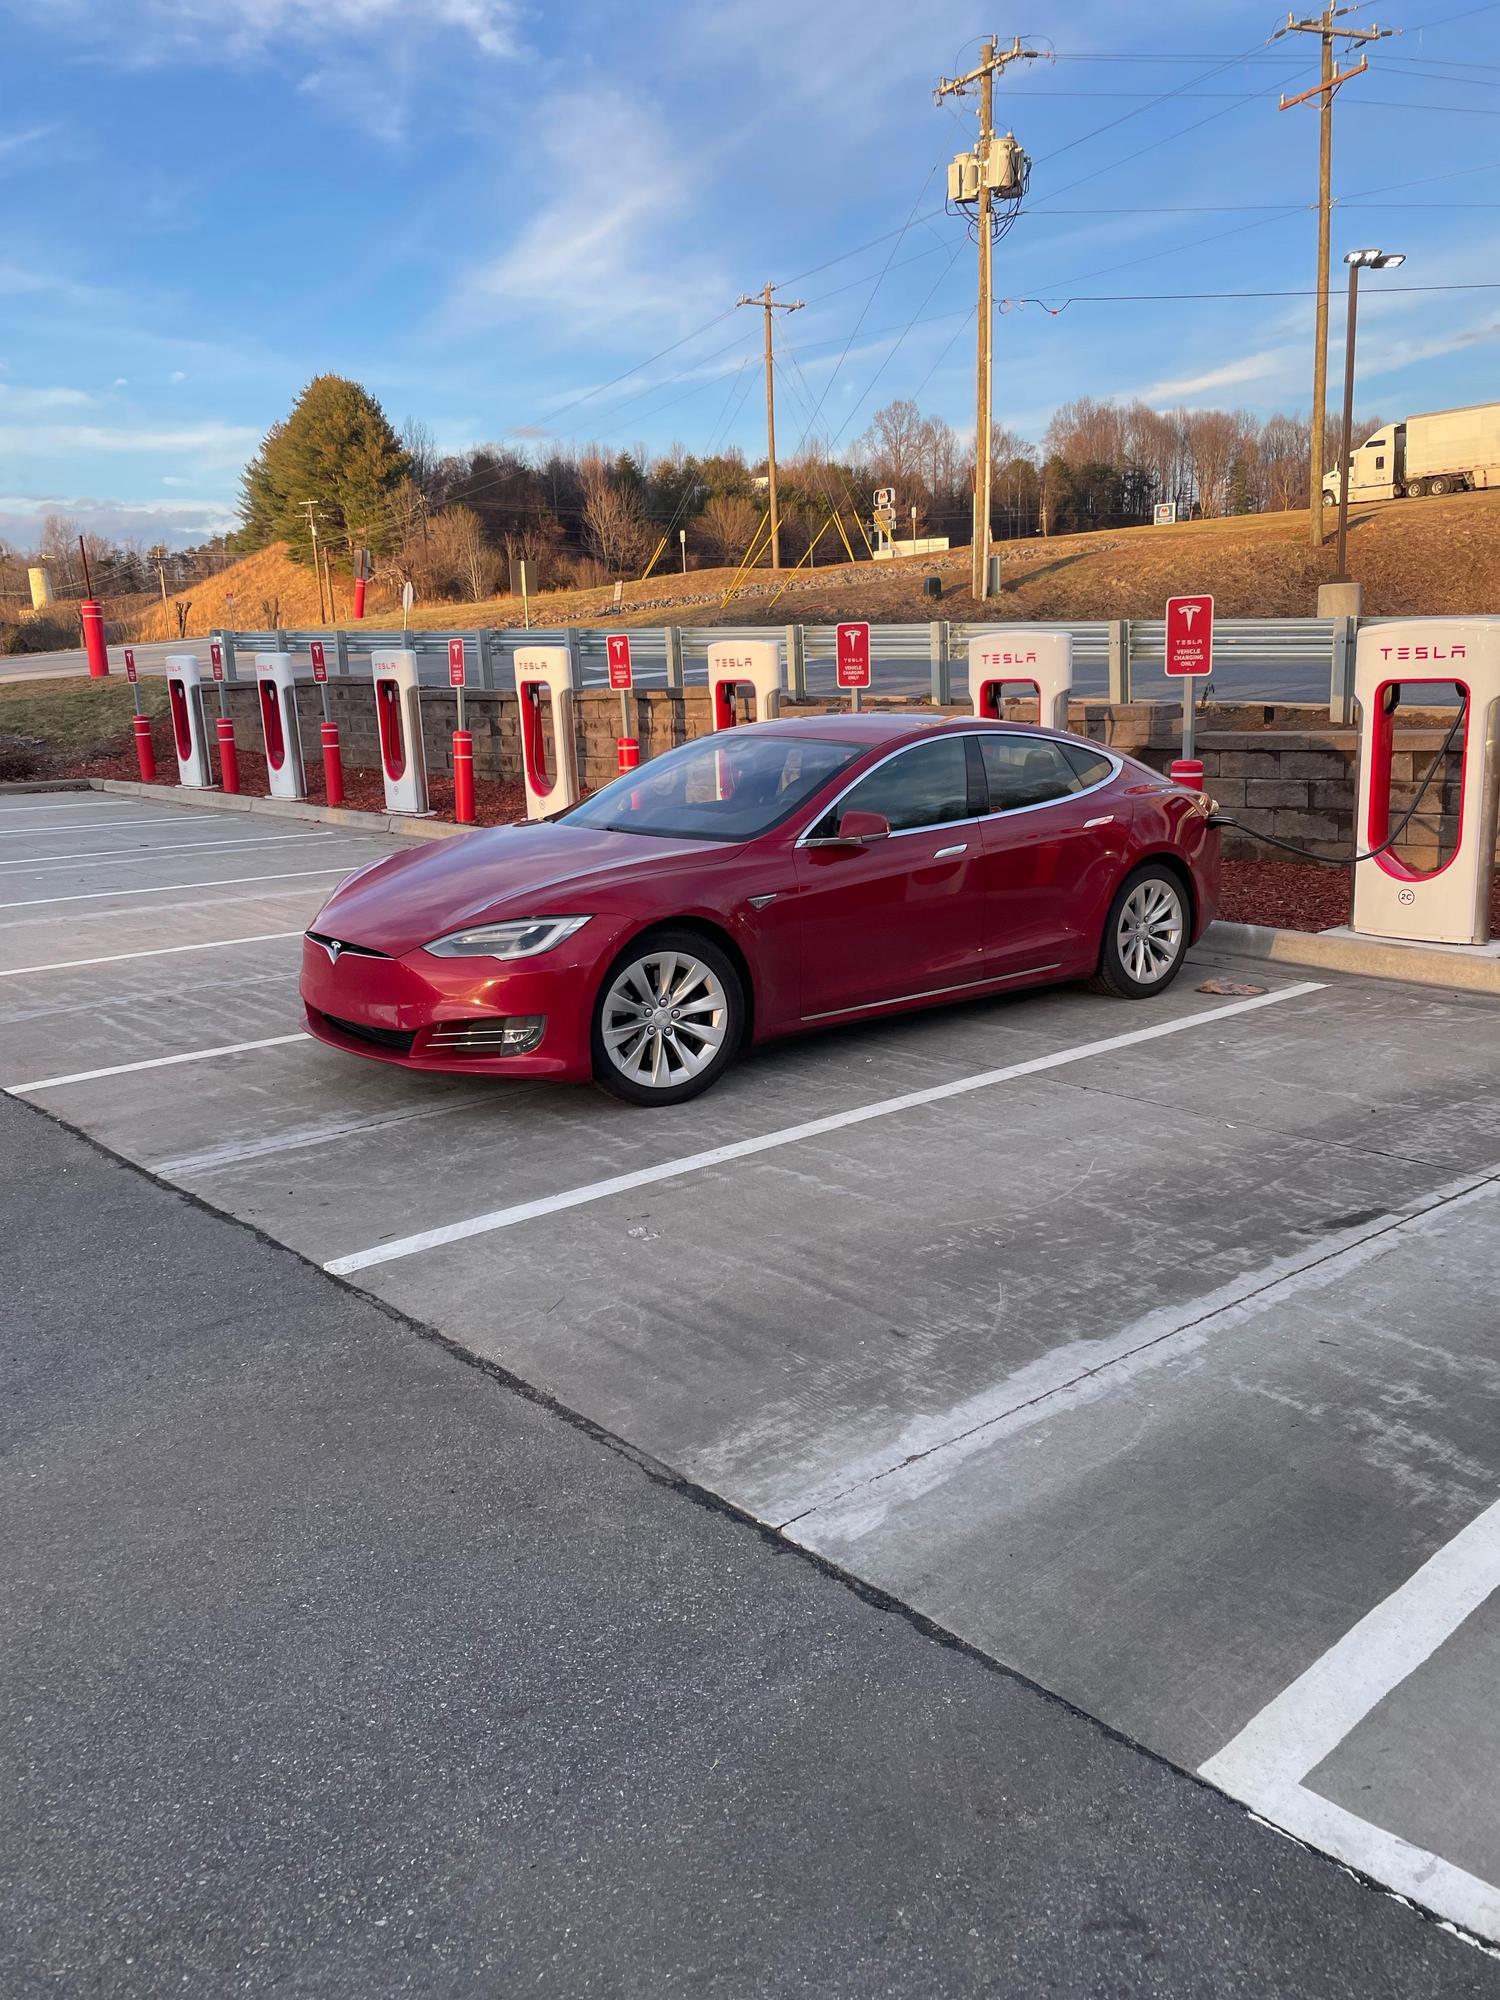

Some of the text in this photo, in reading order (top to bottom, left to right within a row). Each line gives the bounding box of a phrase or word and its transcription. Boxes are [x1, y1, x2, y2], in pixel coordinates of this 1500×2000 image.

[981, 652, 1037, 664] TESLA
[1380, 645, 1466, 660] TESLA
[518, 661, 547, 670] TESLA
[715, 657, 752, 667] TESLA
